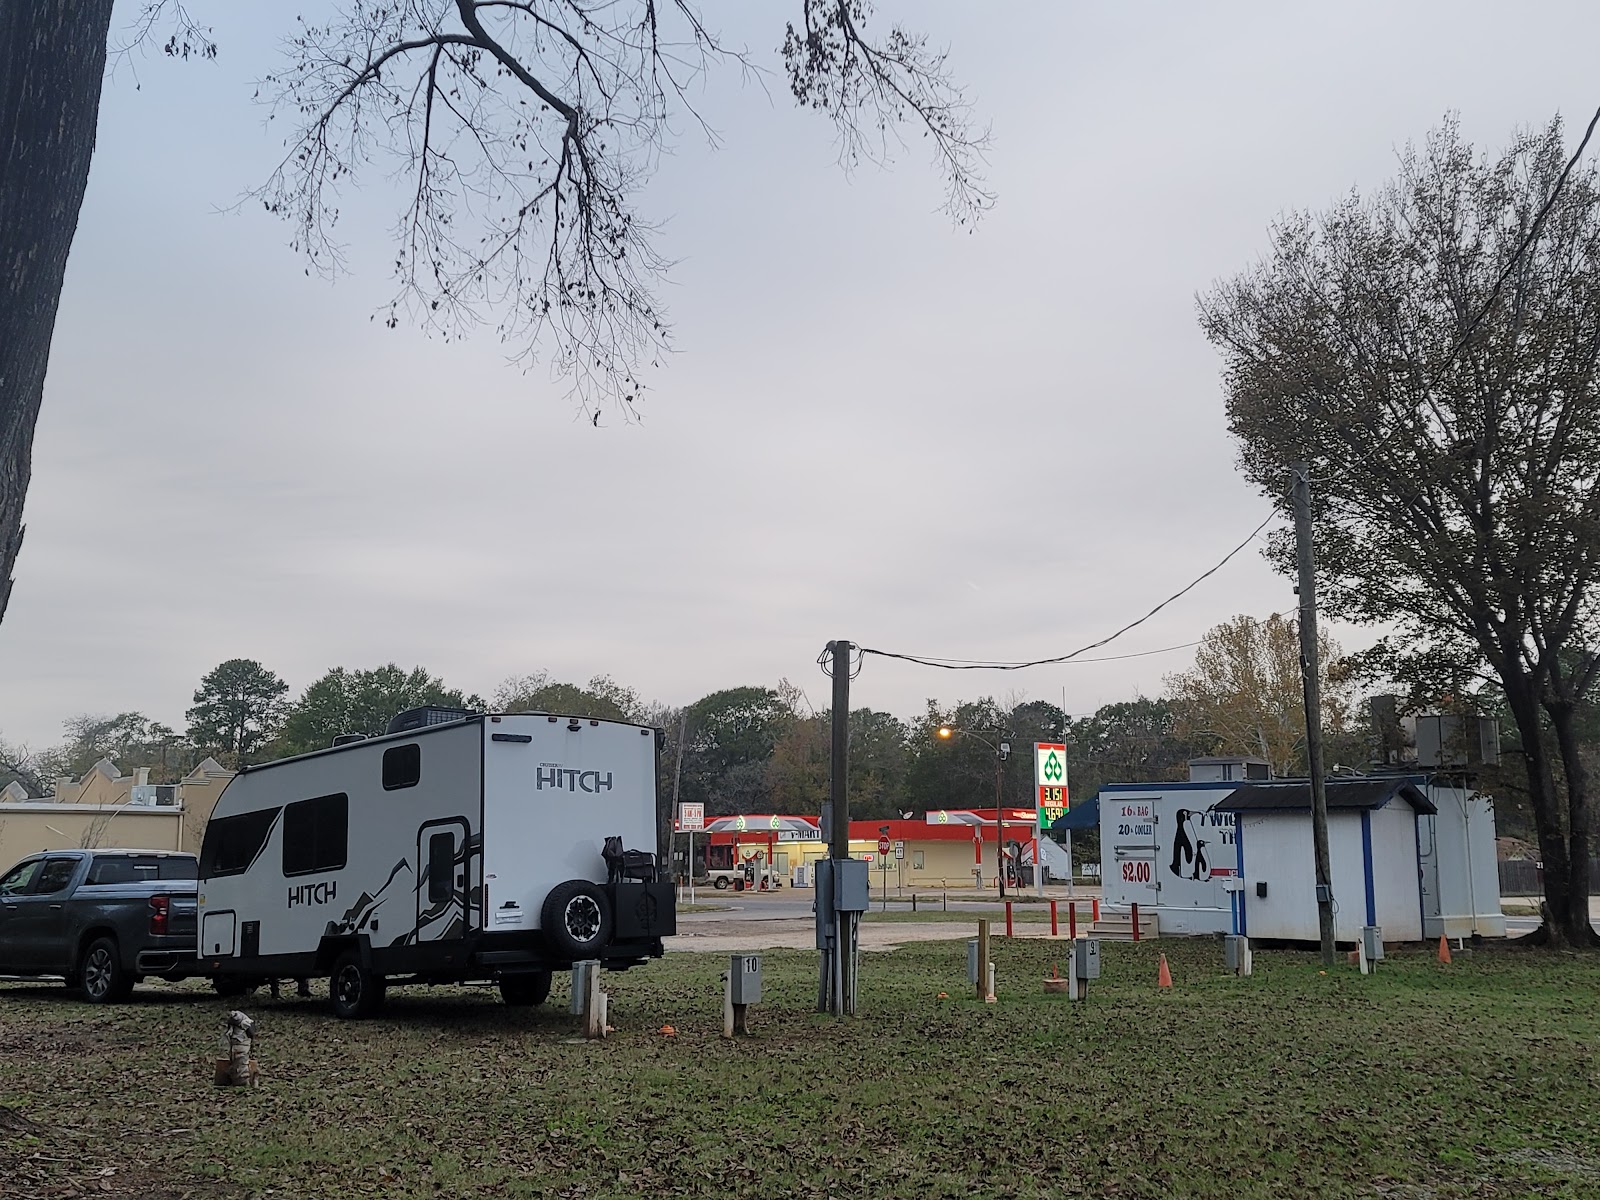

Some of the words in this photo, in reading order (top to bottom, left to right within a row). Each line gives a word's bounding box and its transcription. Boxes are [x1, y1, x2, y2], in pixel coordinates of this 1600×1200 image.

[536, 767, 613, 794] HITCH
[1121, 805, 1133, 817] 16
[1137, 806, 1149, 816] BAG
[1118, 824, 1130, 835] 20
[1134, 824, 1152, 836] COOLER
[878, 841, 890, 850] STOP
[1122, 861, 1151, 883] $2.00
[288, 880, 337, 909] HITCH
[745, 957, 757, 973] 10
